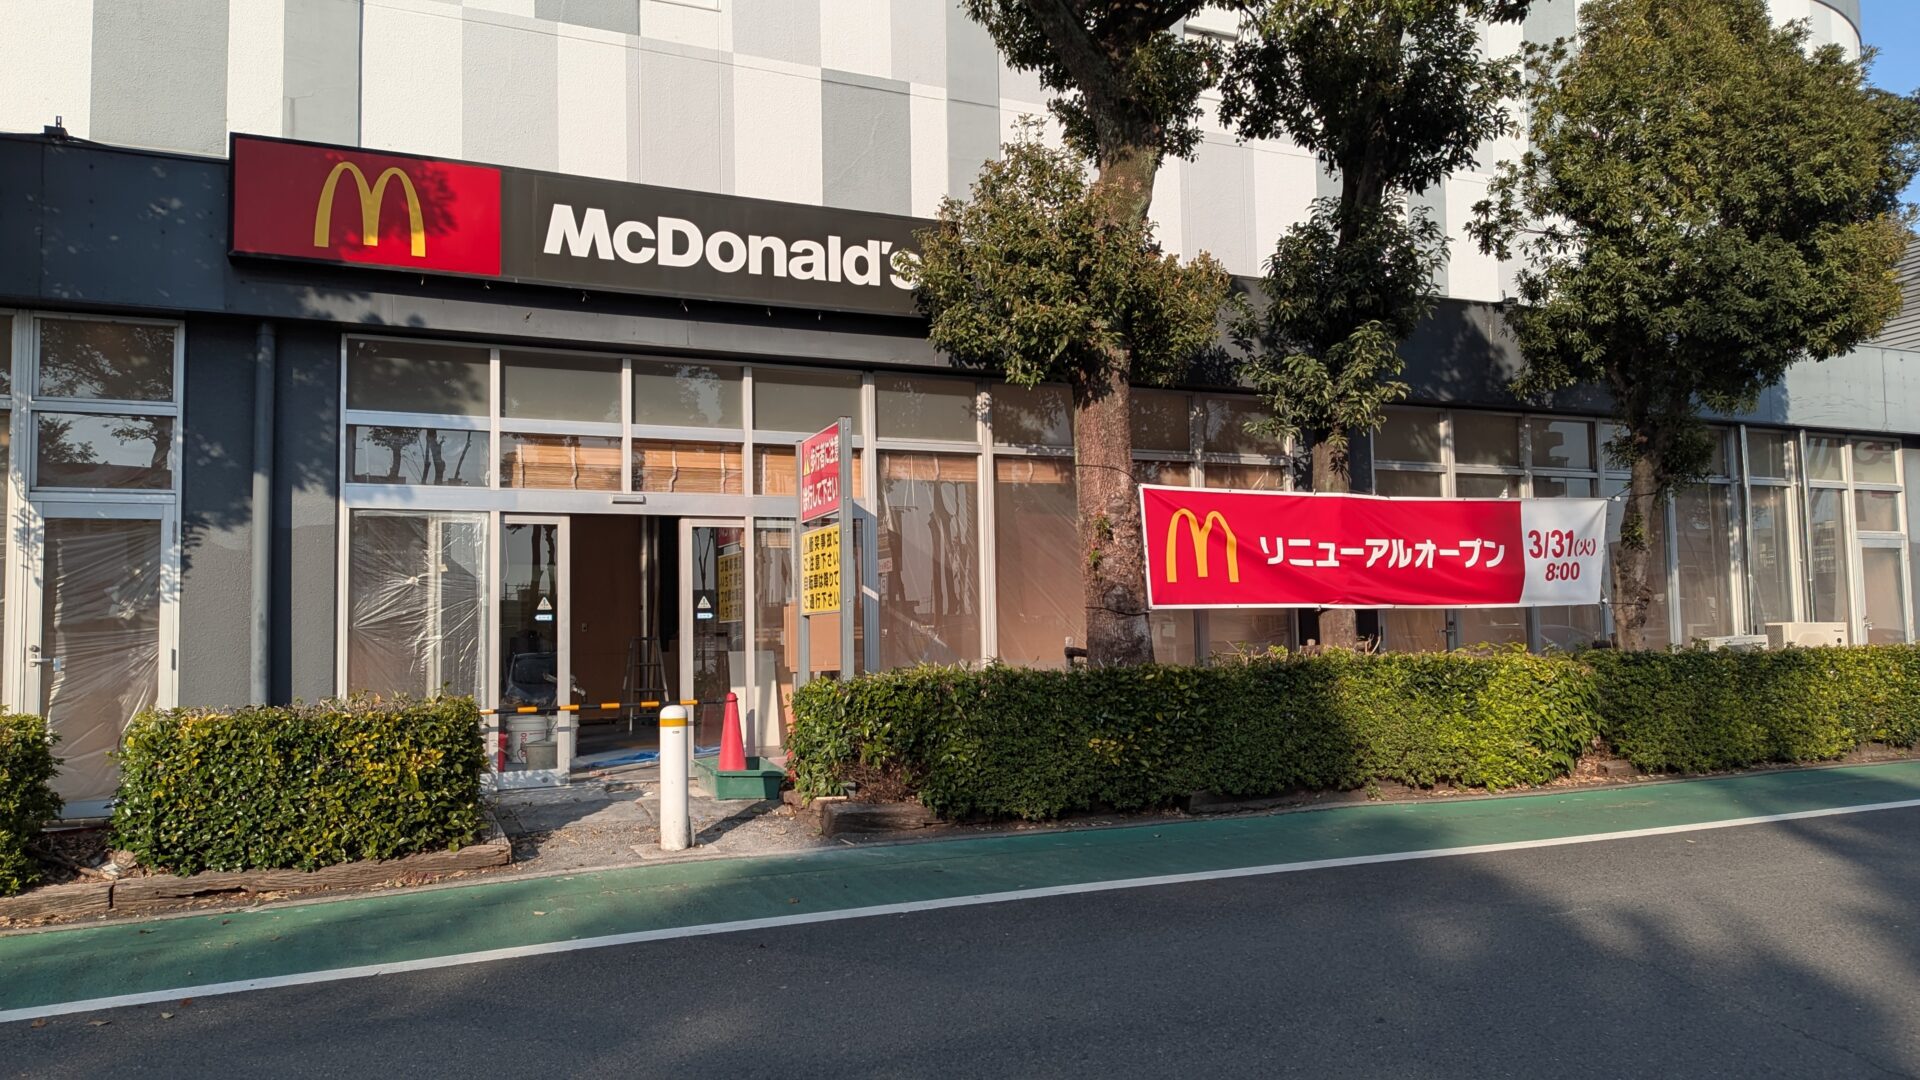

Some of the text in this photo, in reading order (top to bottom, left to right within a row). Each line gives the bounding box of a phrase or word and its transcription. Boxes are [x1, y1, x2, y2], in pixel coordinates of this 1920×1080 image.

[543, 203, 923, 290] McDonald's
[803, 552, 840, 571] ご注意下さい
[1259, 536, 1505, 569] リニューアルオープン
[803, 570, 839, 591] 自転車は降りて
[1545, 561, 1580, 581] 8:00
